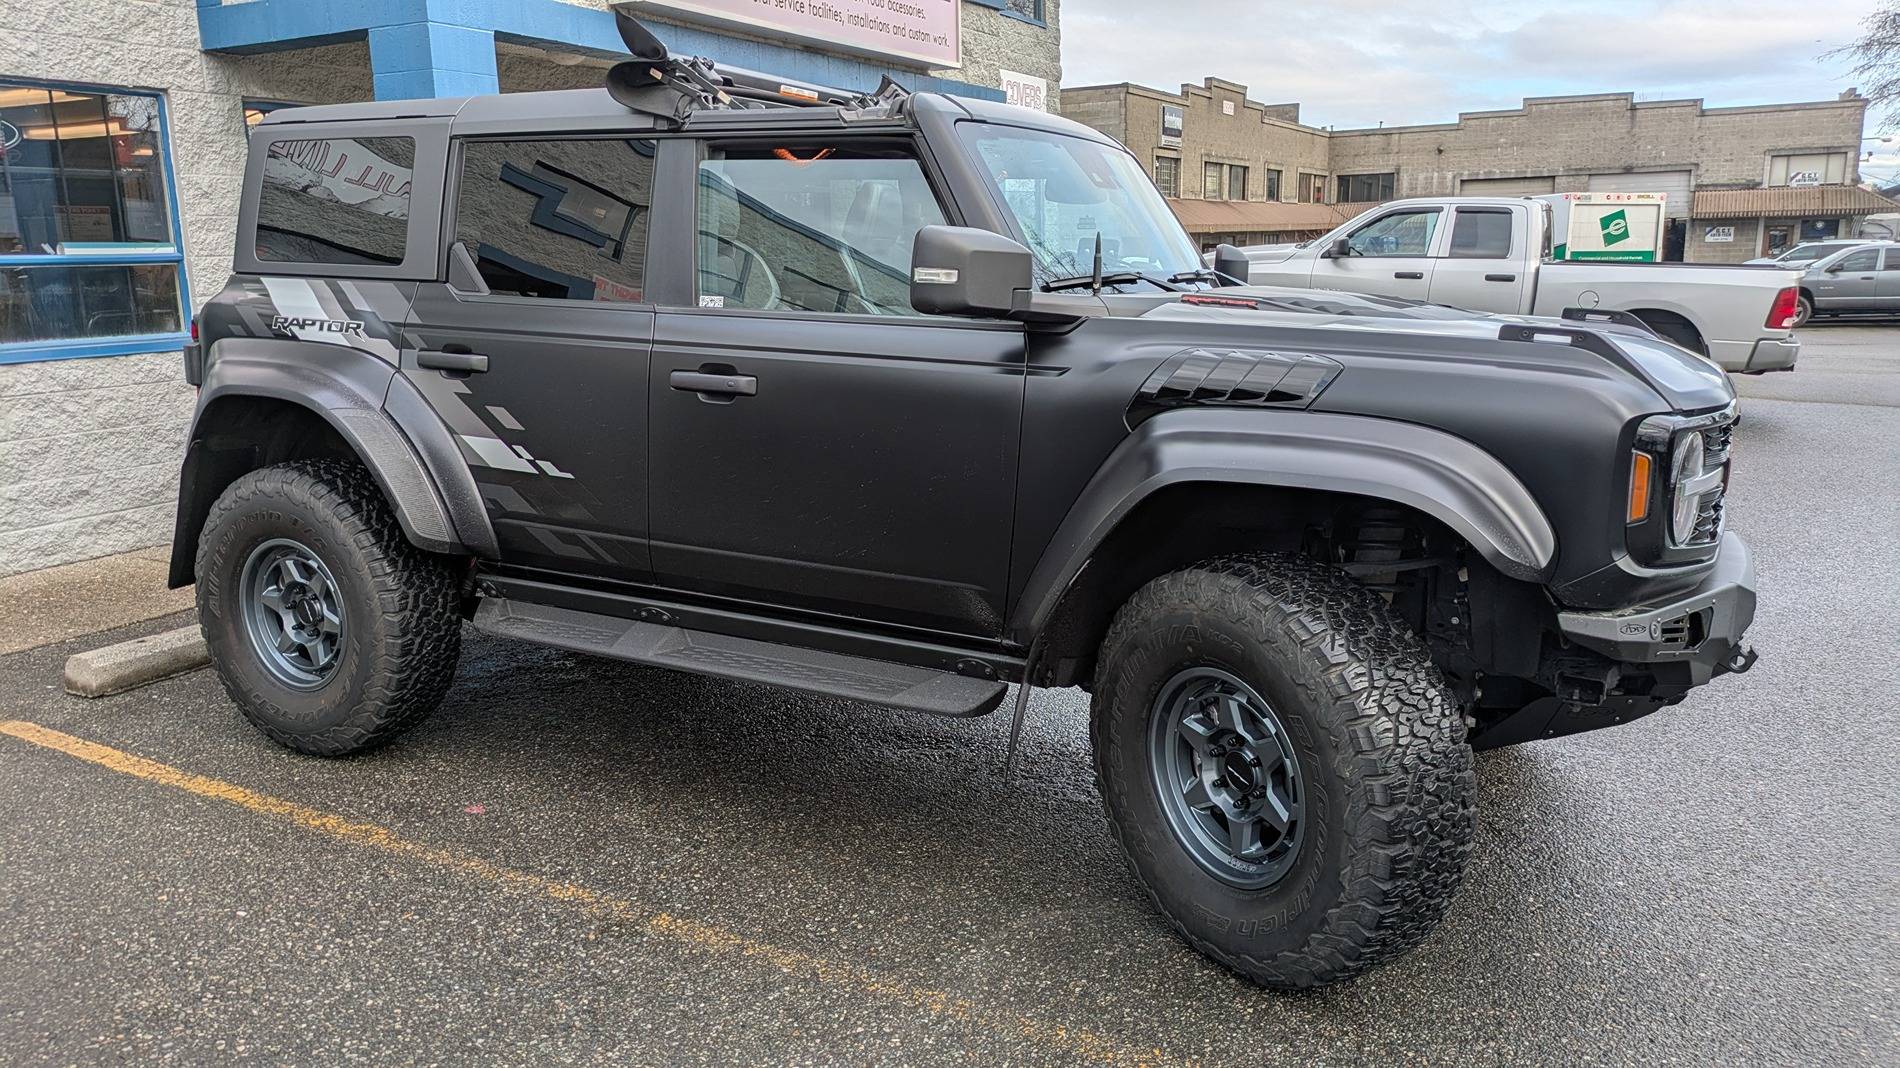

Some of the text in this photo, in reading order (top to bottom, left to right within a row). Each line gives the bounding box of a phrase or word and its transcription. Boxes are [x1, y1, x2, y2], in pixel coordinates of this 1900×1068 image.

[774, 0, 951, 48] service facilities, installations and custom work.
[887, 0, 927, 19] accessories.
[1005, 80, 1042, 110] COVERS
[272, 315, 366, 343] RAPTOR
